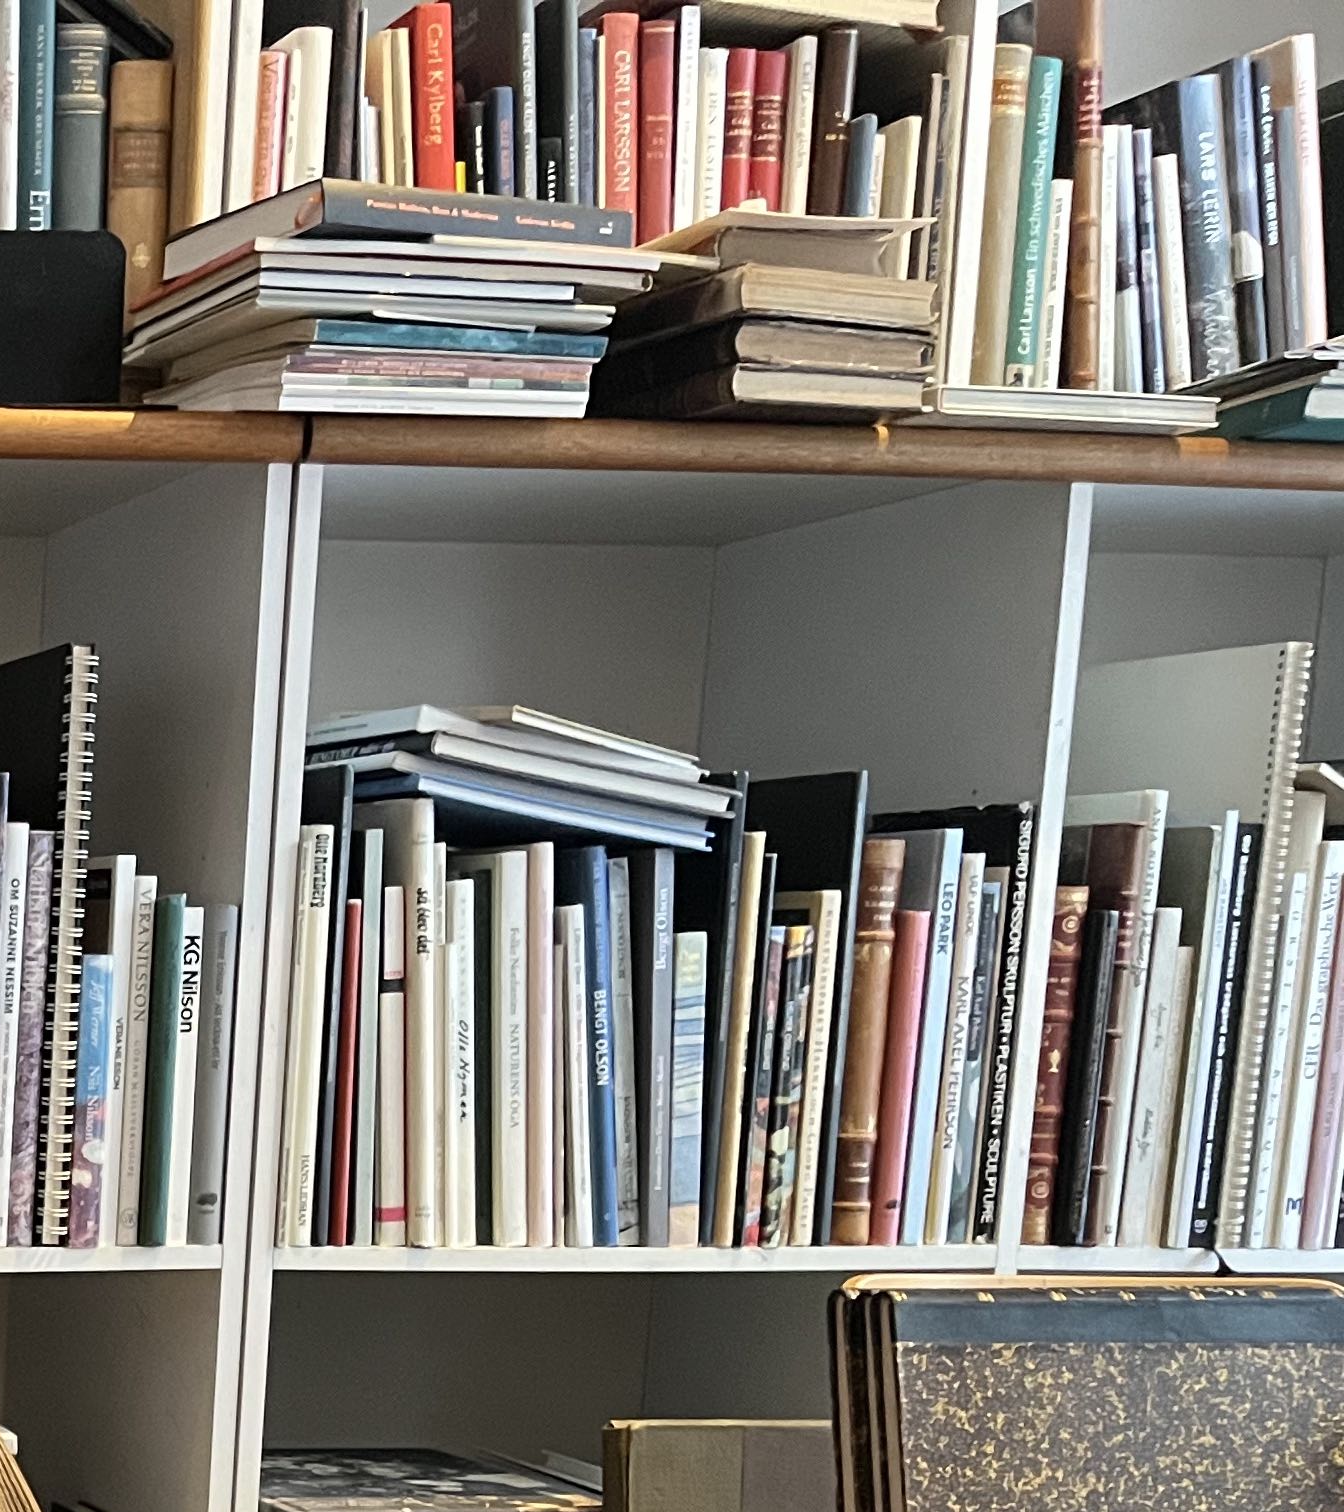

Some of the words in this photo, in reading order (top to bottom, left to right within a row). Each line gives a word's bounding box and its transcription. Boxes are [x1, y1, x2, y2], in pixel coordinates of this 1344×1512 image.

[426, 23, 443, 63] Carl
[614, 50, 631, 95] CARL
[423, 70, 444, 146] Kylberg
[615, 99, 631, 192] LARSSON
[1198, 131, 1218, 181] LARS
[1200, 189, 1223, 244] LERIN
[1017, 268, 1038, 324] Larsson
[1017, 327, 1031, 355] Carl
[1015, 819, 1034, 878] SIGURD
[9, 878, 20, 901] OM
[137, 889, 152, 935] VERA
[655, 888, 670, 929] Olson
[940, 883, 955, 912] LEO
[5, 905, 19, 963] SUZANNE
[937, 915, 952, 955] PARK
[1008, 881, 1028, 954] PERSSON
[183, 935, 201, 965] KG
[3, 967, 16, 1015] NESSIM
[132, 940, 150, 1023] NILSSON
[179, 970, 199, 1033] Nilson
[955, 976, 971, 1018] KARL
[999, 955, 1020, 1033] SKULPTUR
[593, 989, 608, 1036] BENGT
[509, 1024, 522, 1096] NATURENS
[595, 1039, 610, 1086] OLSON
[951, 1022, 968, 1066] AXEL
[990, 1044, 1011, 1125] PLASTIKEN
[980, 1138, 1001, 1224] SCULPTURE
